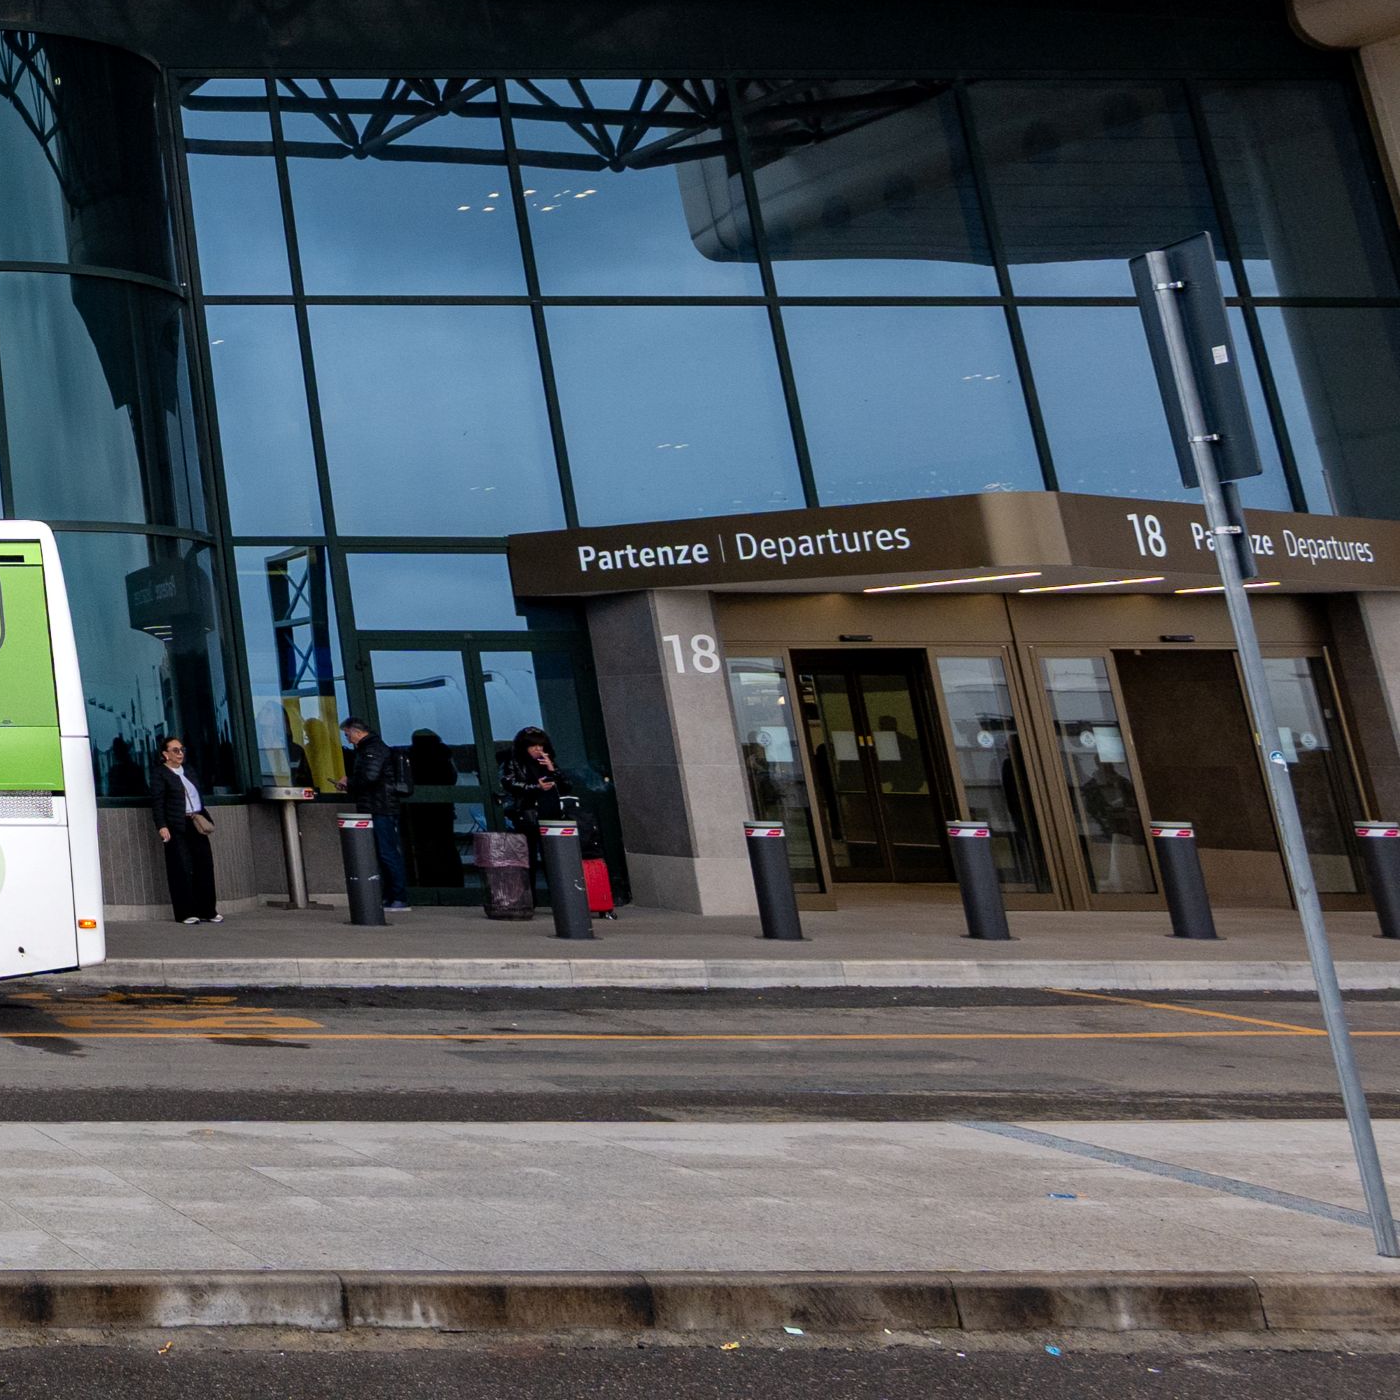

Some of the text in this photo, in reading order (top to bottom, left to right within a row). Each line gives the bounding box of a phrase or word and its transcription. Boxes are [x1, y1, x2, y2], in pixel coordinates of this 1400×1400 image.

[577, 527, 911, 572] Partenze Departures
[1127, 513, 1375, 566] 18 Paze Departures
[662, 634, 720, 674] 18
